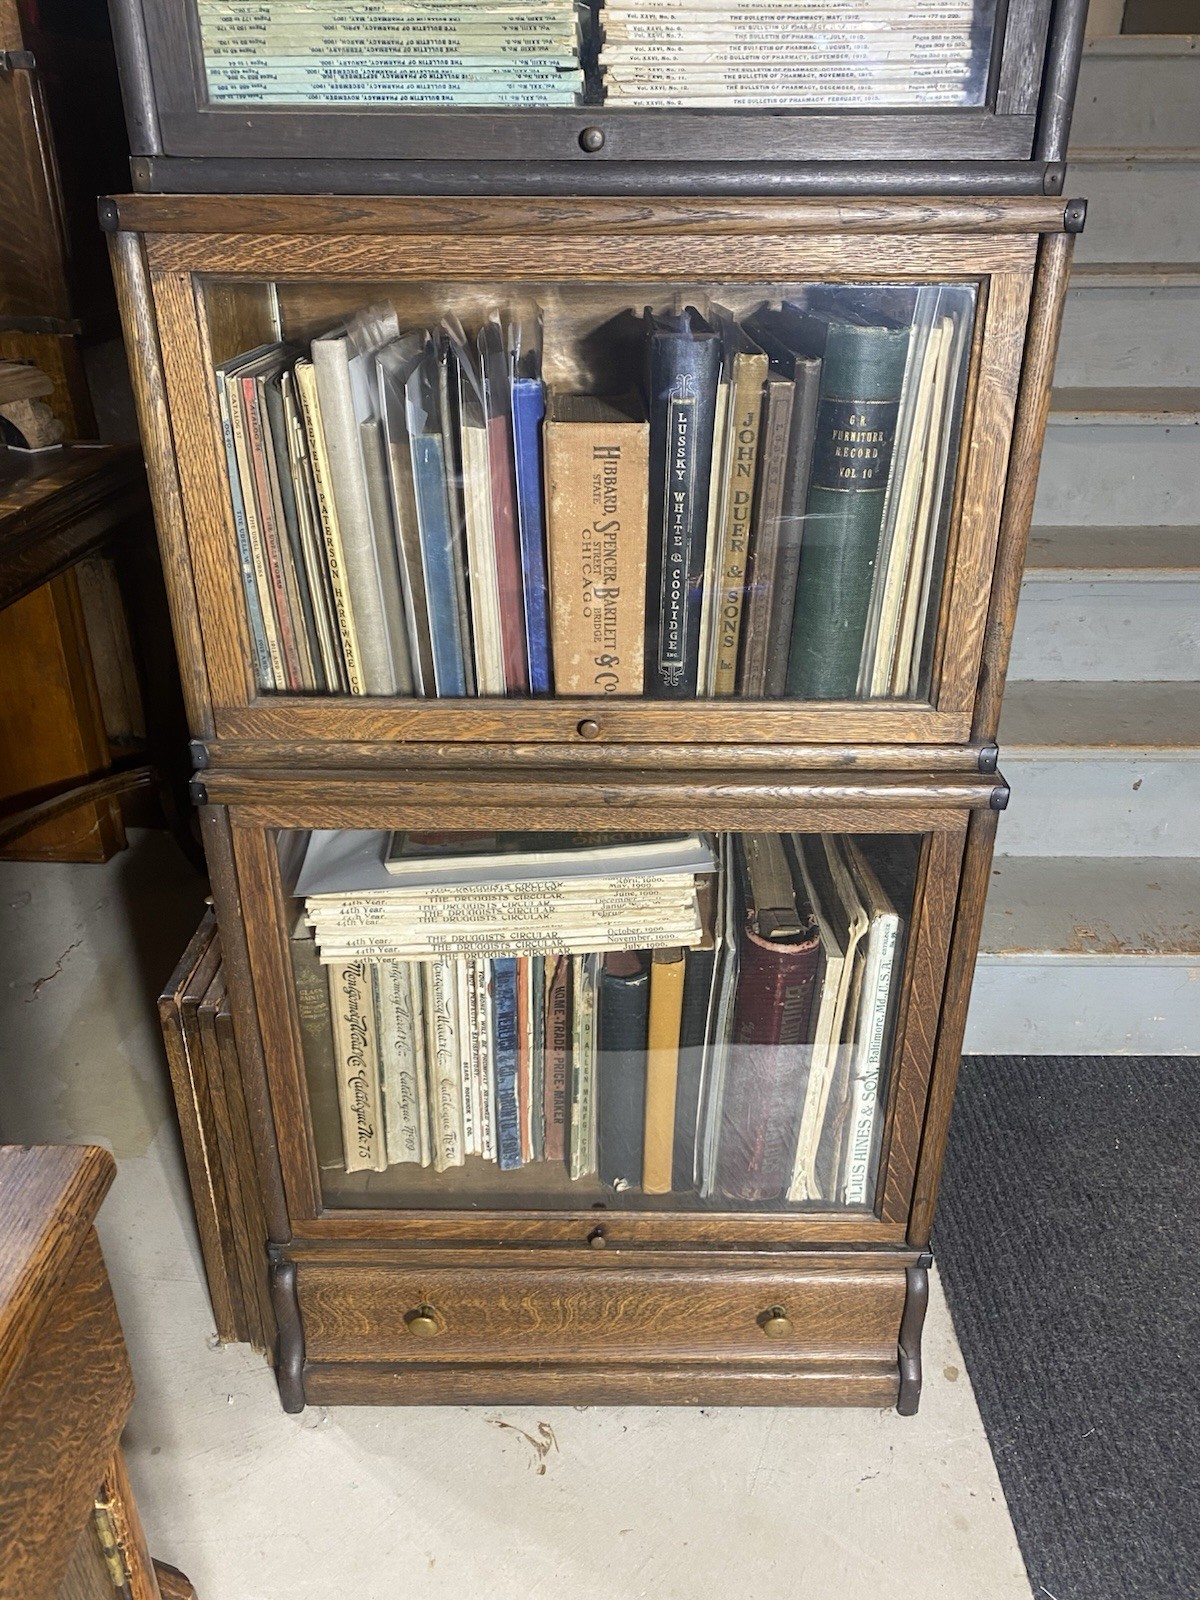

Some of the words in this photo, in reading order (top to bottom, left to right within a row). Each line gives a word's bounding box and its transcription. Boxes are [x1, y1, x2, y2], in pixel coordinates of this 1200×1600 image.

[231, 393, 242, 431] CATALOG
[675, 412, 687, 481] LUSSKY
[737, 411, 755, 478] JOHN
[832, 429, 885, 442] FURNITURE
[835, 447, 879, 459] RECORD
[592, 473, 600, 505] STATE
[593, 446, 621, 517] HIBBARD,
[839, 467, 857, 479] VOL
[862, 468, 873, 479] 10
[673, 491, 685, 547] WHITE
[729, 490, 751, 553] DUER
[239, 528, 249, 555] UDELL
[250, 531, 260, 552] UDELL
[592, 541, 601, 576] STREET
[593, 520, 621, 585] SPENCER,
[671, 553, 683, 564] &
[254, 553, 264, 578] WORKS
[318, 493, 339, 580] PATERSON
[334, 588, 355, 668] HARDWARE
[581, 528, 593, 619] CHICAGO
[726, 564, 743, 579] &
[593, 586, 621, 651] BARTLETT
[593, 607, 602, 643] BRIDGE
[667, 569, 682, 651] COOLIDGE
[722, 591, 740, 649] SONS
[594, 653, 620, 669] &
[340, 907, 360, 915] 44th
[430, 895, 449, 903] THE
[455, 893, 510, 902] DRUGGISTS
[513, 892, 565, 900] CIRCULAR.
[345, 938, 366, 946] 44th
[368, 937, 391, 945] Year.
[426, 935, 448, 944] THE
[451, 932, 506, 943] DRUGGISTS
[509, 931, 561, 941] CIRCULAR.
[607, 927, 643, 937] October,
[431, 943, 452, 952] THE
[455, 941, 512, 951] DRUGGISTS
[515, 939, 567, 949] CIRCULAR.
[607, 934, 655, 943] November,
[438, 952, 459, 961] THE
[463, 950, 519, 960] DRUGGISTS
[522, 947, 573, 957] CIRCULAR.
[622, 942, 645, 951] July,
[343, 963, 367, 1025] Montgomery
[348, 1016, 368, 1050] Ward
[868, 1014, 885, 1064] Baltimore,
[462, 1061, 470, 1083] SEARS,
[862, 1067, 881, 1103] SON,
[347, 1069, 370, 1126] Catalogue
[397, 1070, 416, 1122] Catalogue
[440, 1078, 456, 1131] Catalogue
[464, 1087, 472, 1115] ROEBUCK
[862, 1105, 874, 1117] &
[359, 1145, 371, 1160] 75
[852, 1118, 872, 1161] HINES
